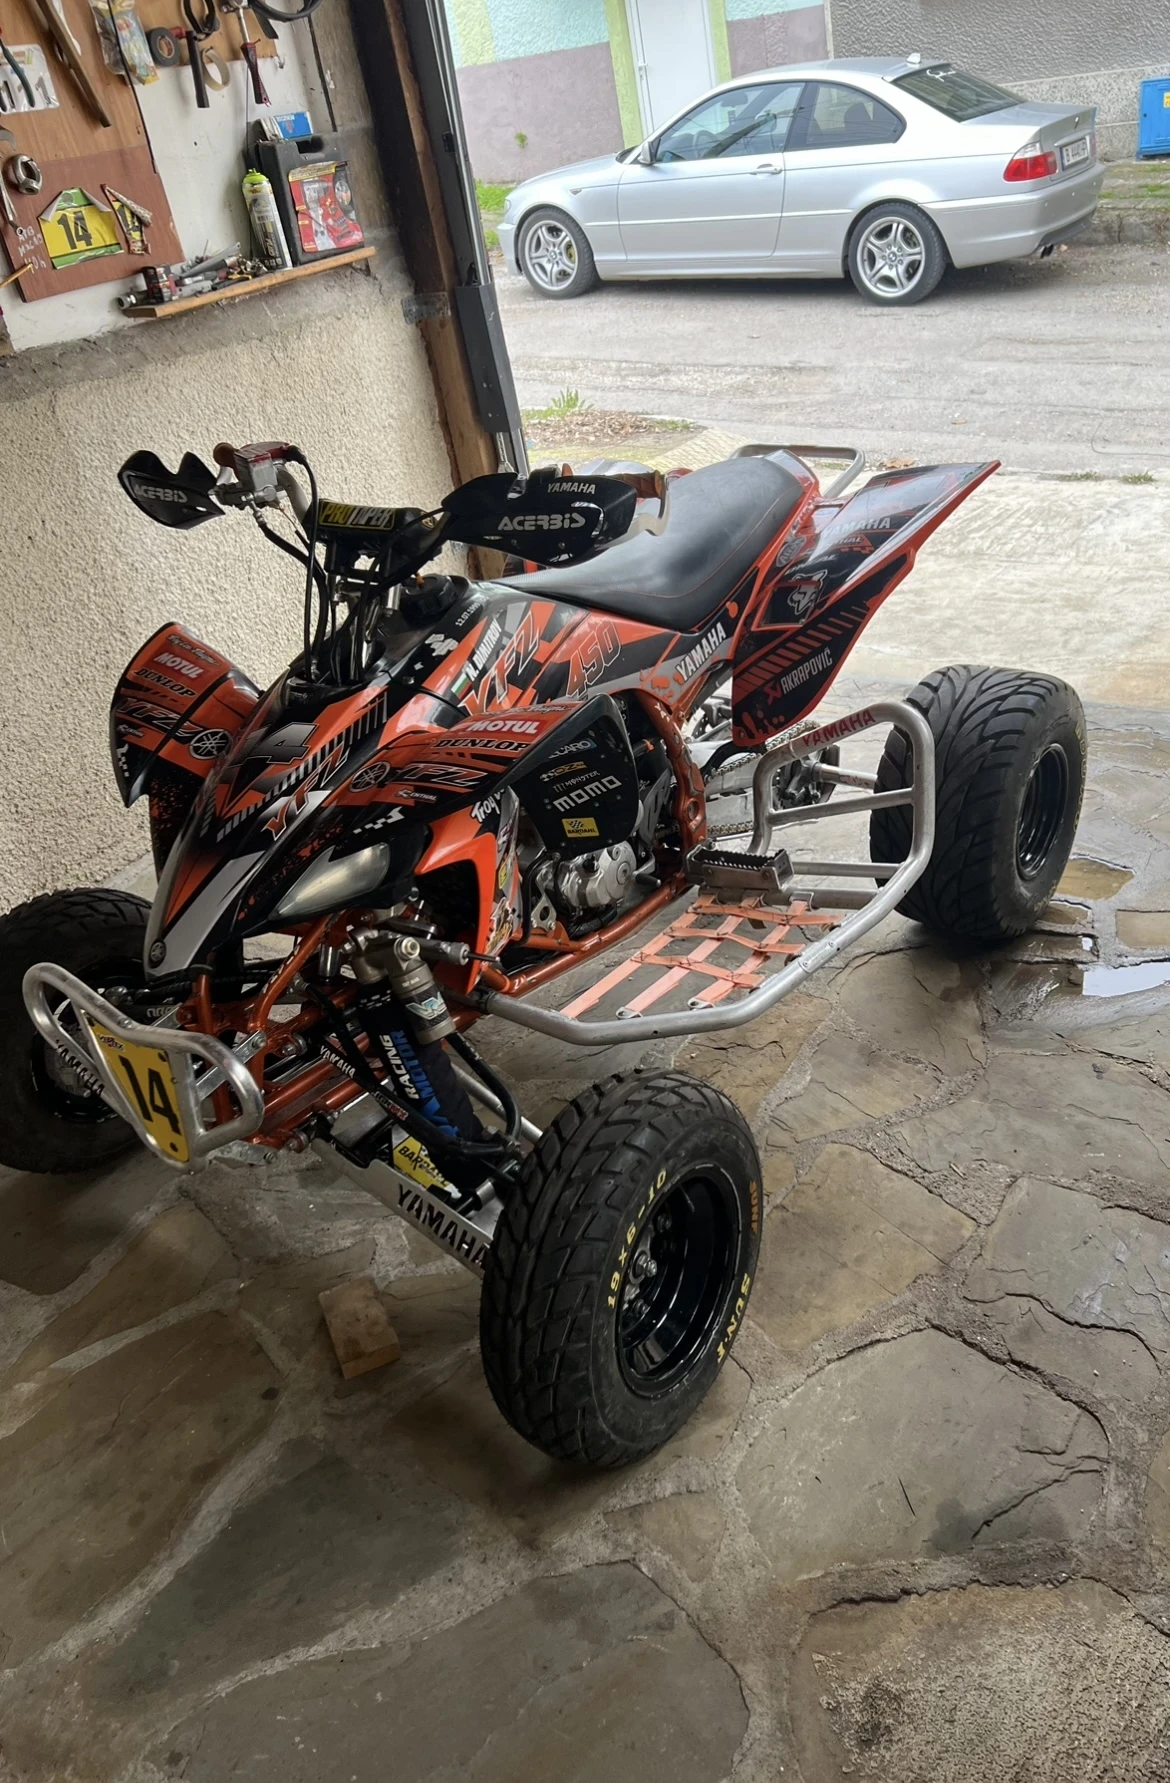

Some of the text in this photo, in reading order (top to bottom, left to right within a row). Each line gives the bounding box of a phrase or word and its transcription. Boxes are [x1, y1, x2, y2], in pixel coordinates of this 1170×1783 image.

[57, 210, 93, 251] 14
[547, 482, 597, 495] YAMAHA
[154, 652, 205, 679] MOTUL
[457, 610, 541, 717] YFZ
[465, 617, 502, 682] N. DIMITROV
[566, 619, 622, 699] 450
[676, 621, 727, 684] YAMAHA
[780, 647, 834, 696] AKRAPOVIČ
[134, 668, 197, 698] DUNLOP
[434, 739, 532, 752] DUNLOP
[467, 720, 541, 735] MOTUL
[801, 708, 877, 748] YAMAHA
[260, 742, 351, 842] YFZ
[319, 1044, 357, 1079] YAMAHA
[378, 1034, 420, 1100] RACING
[119, 1055, 182, 1137] 14
[397, 1183, 492, 1268] YAMAHA
